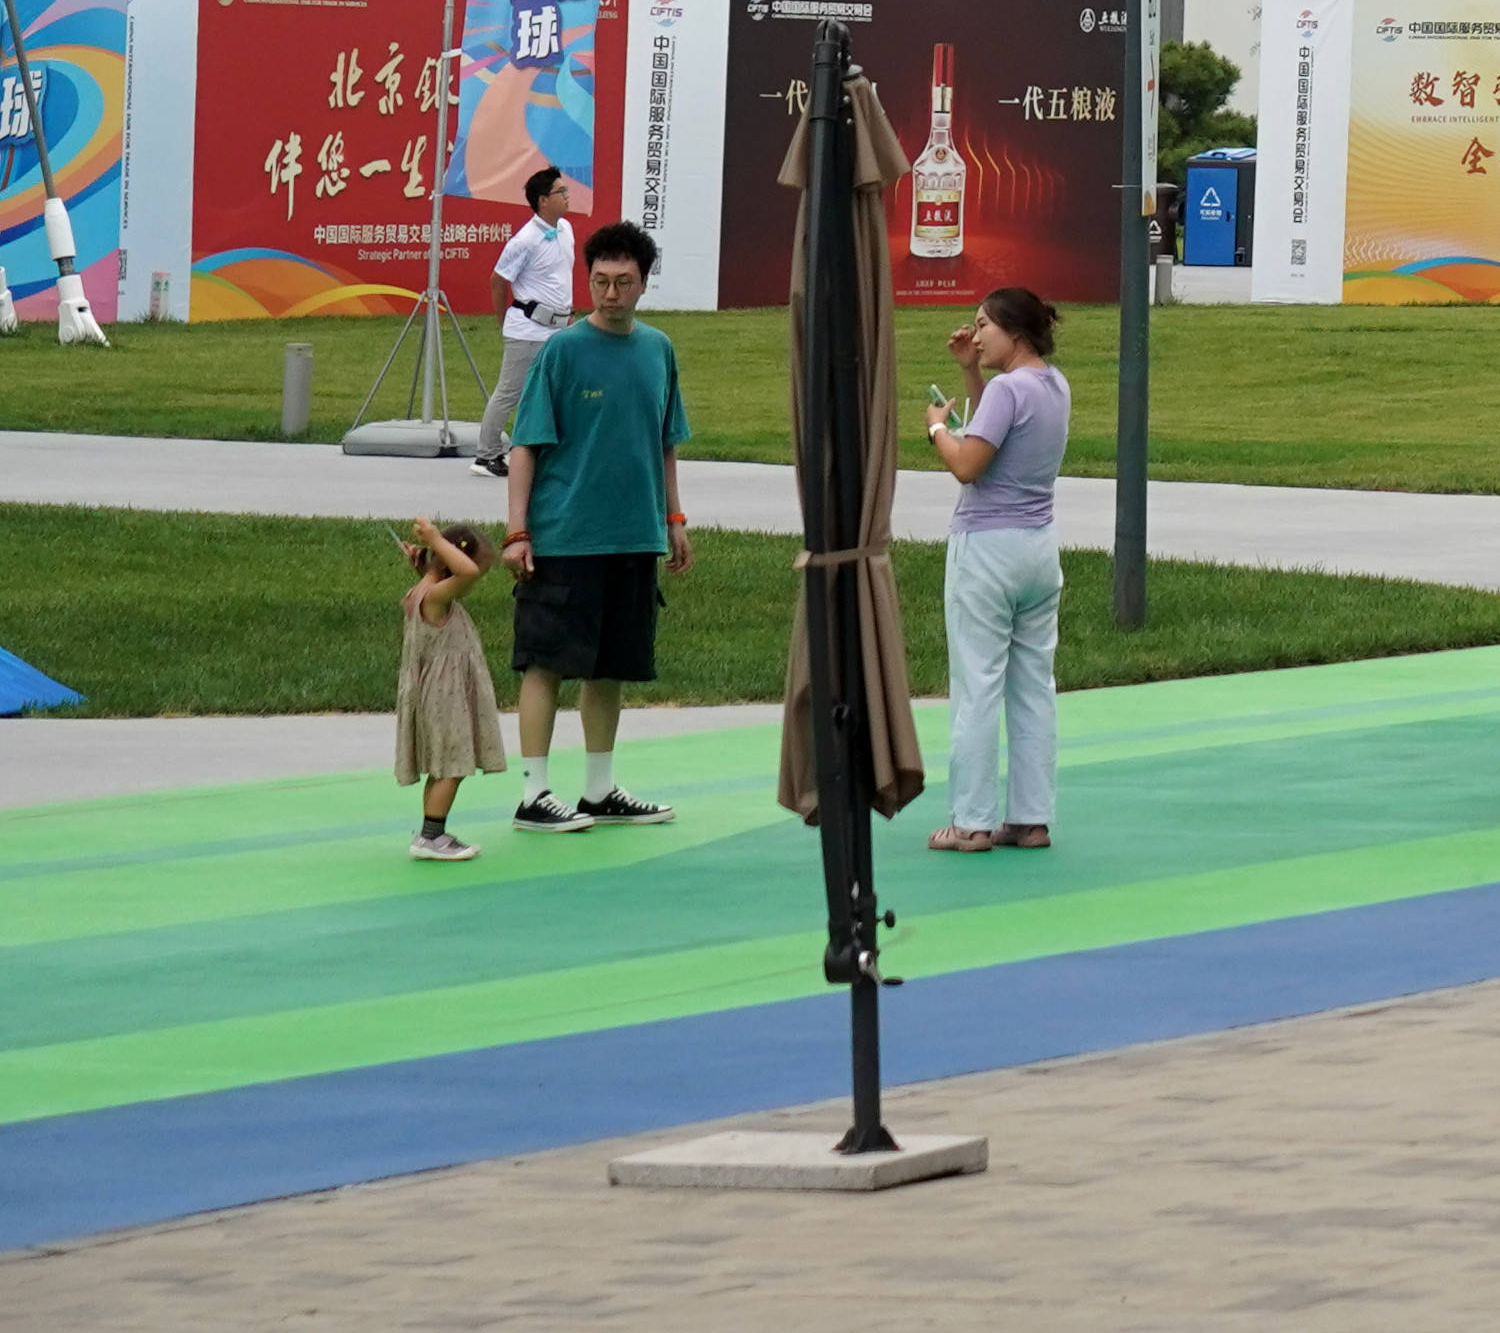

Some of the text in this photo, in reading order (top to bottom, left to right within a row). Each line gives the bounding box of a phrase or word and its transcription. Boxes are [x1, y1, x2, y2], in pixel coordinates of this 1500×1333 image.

[650, 6, 683, 18] CIFTIS
[998, 85, 1117, 122] 一代五粮液
[1411, 115, 1447, 124] EMBRACE
[1449, 115, 1500, 124] INTELLIGENT
[643, 34, 670, 230] 中国国际服务贸易交易会
[1293, 46, 1310, 224] 中国国际服务贸易交易会
[265, 132, 455, 222] 伴您一生
[357, 248, 391, 263] Strategic
[393, 248, 422, 260] Partner
[444, 247, 470, 259] CIFTIS
